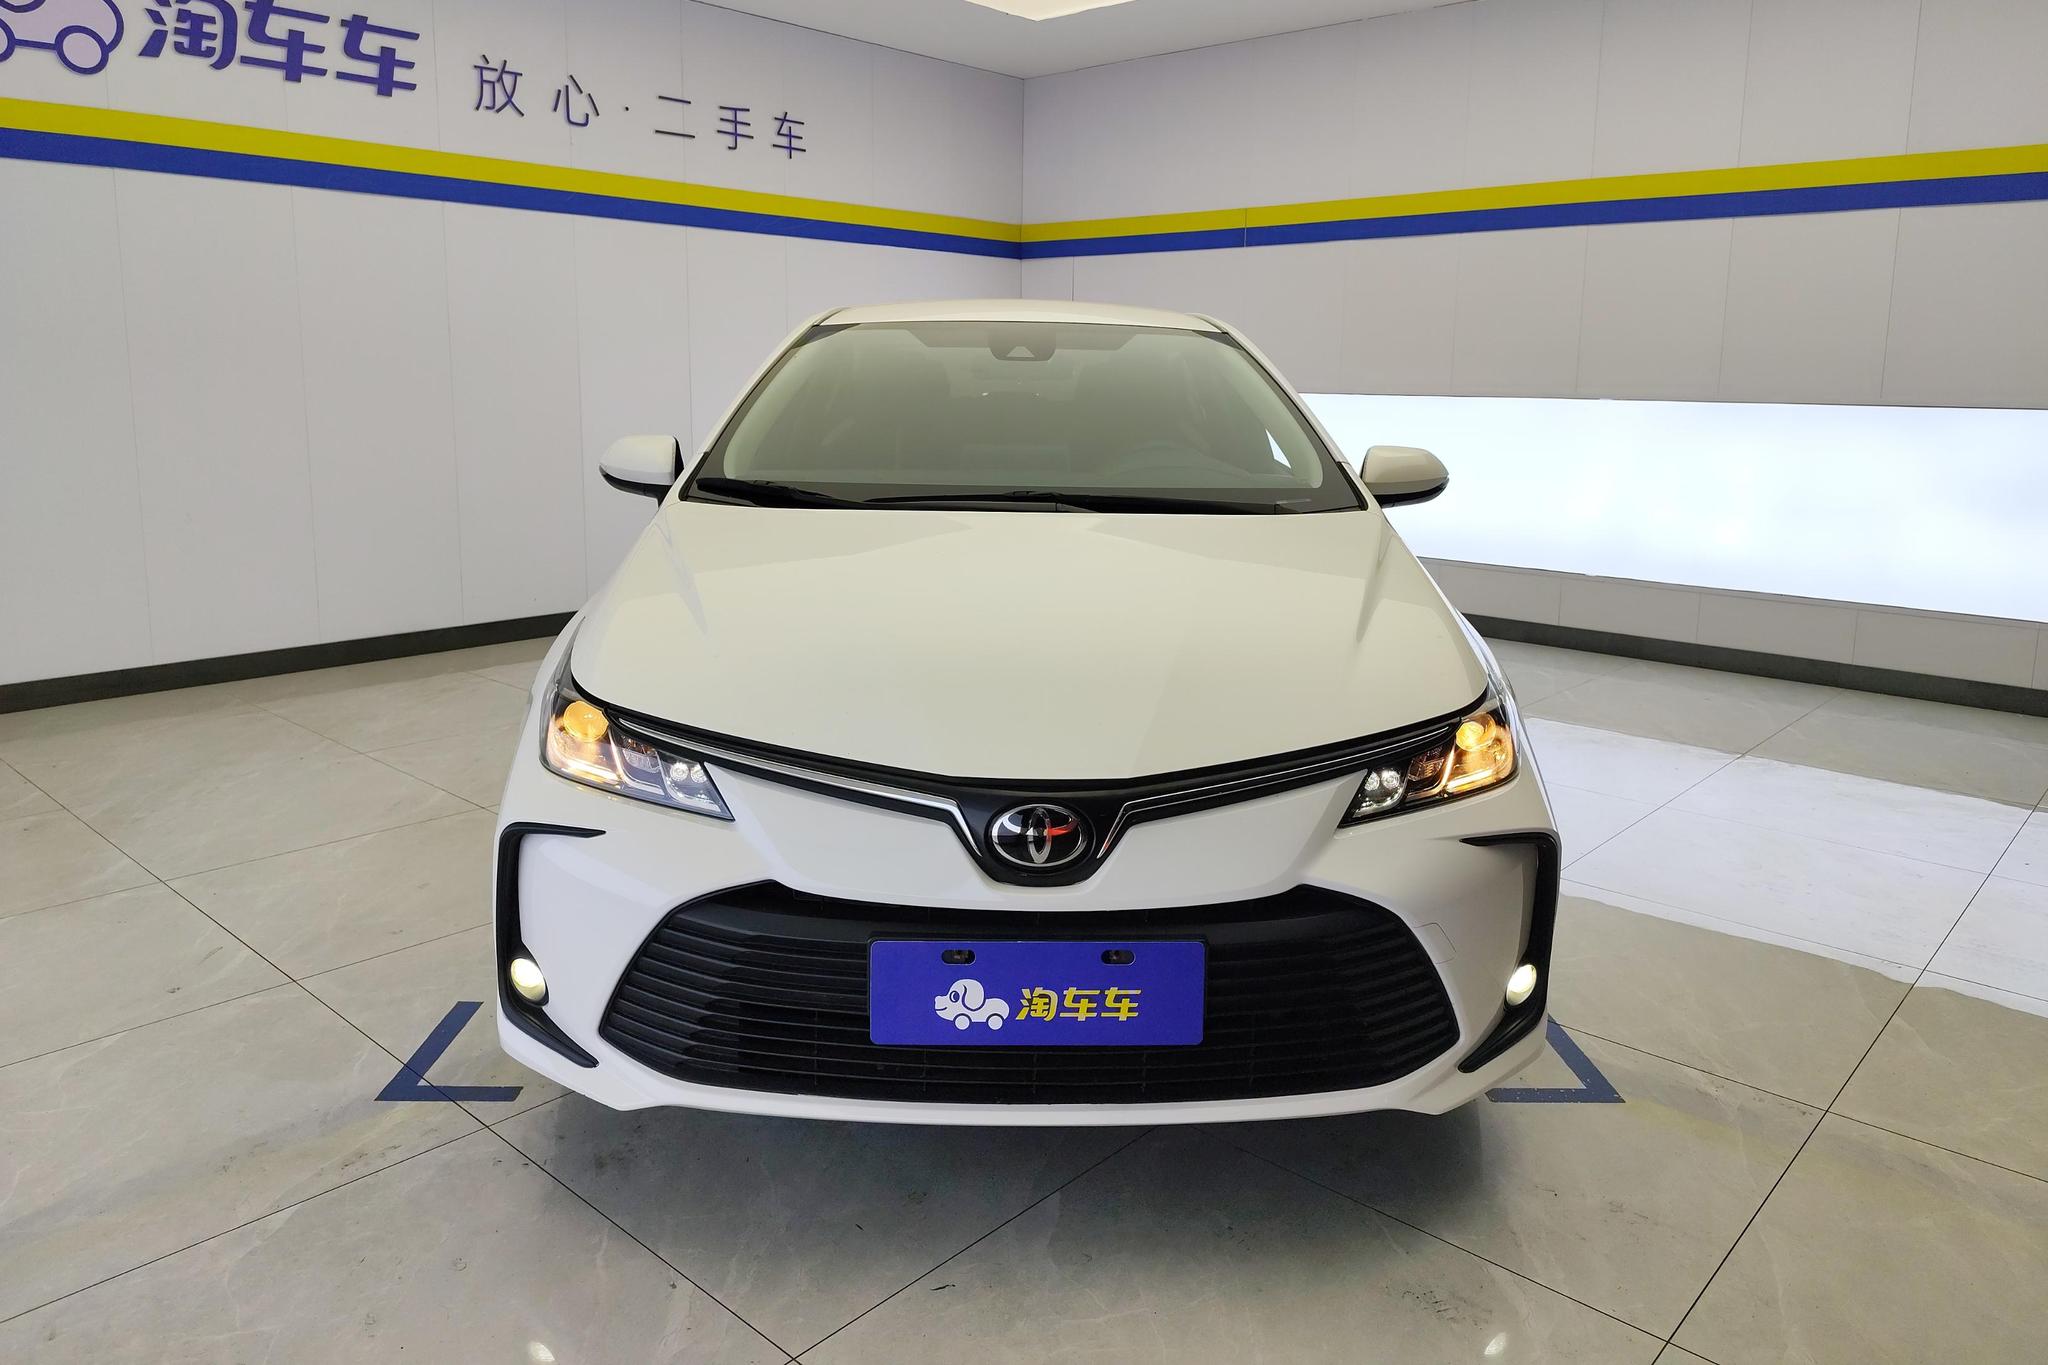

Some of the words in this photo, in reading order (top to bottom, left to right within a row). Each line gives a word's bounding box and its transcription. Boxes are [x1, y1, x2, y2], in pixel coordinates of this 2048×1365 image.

[138, 0, 420, 97] 淘车车
[1015, 986, 1142, 1022] 淘车车
